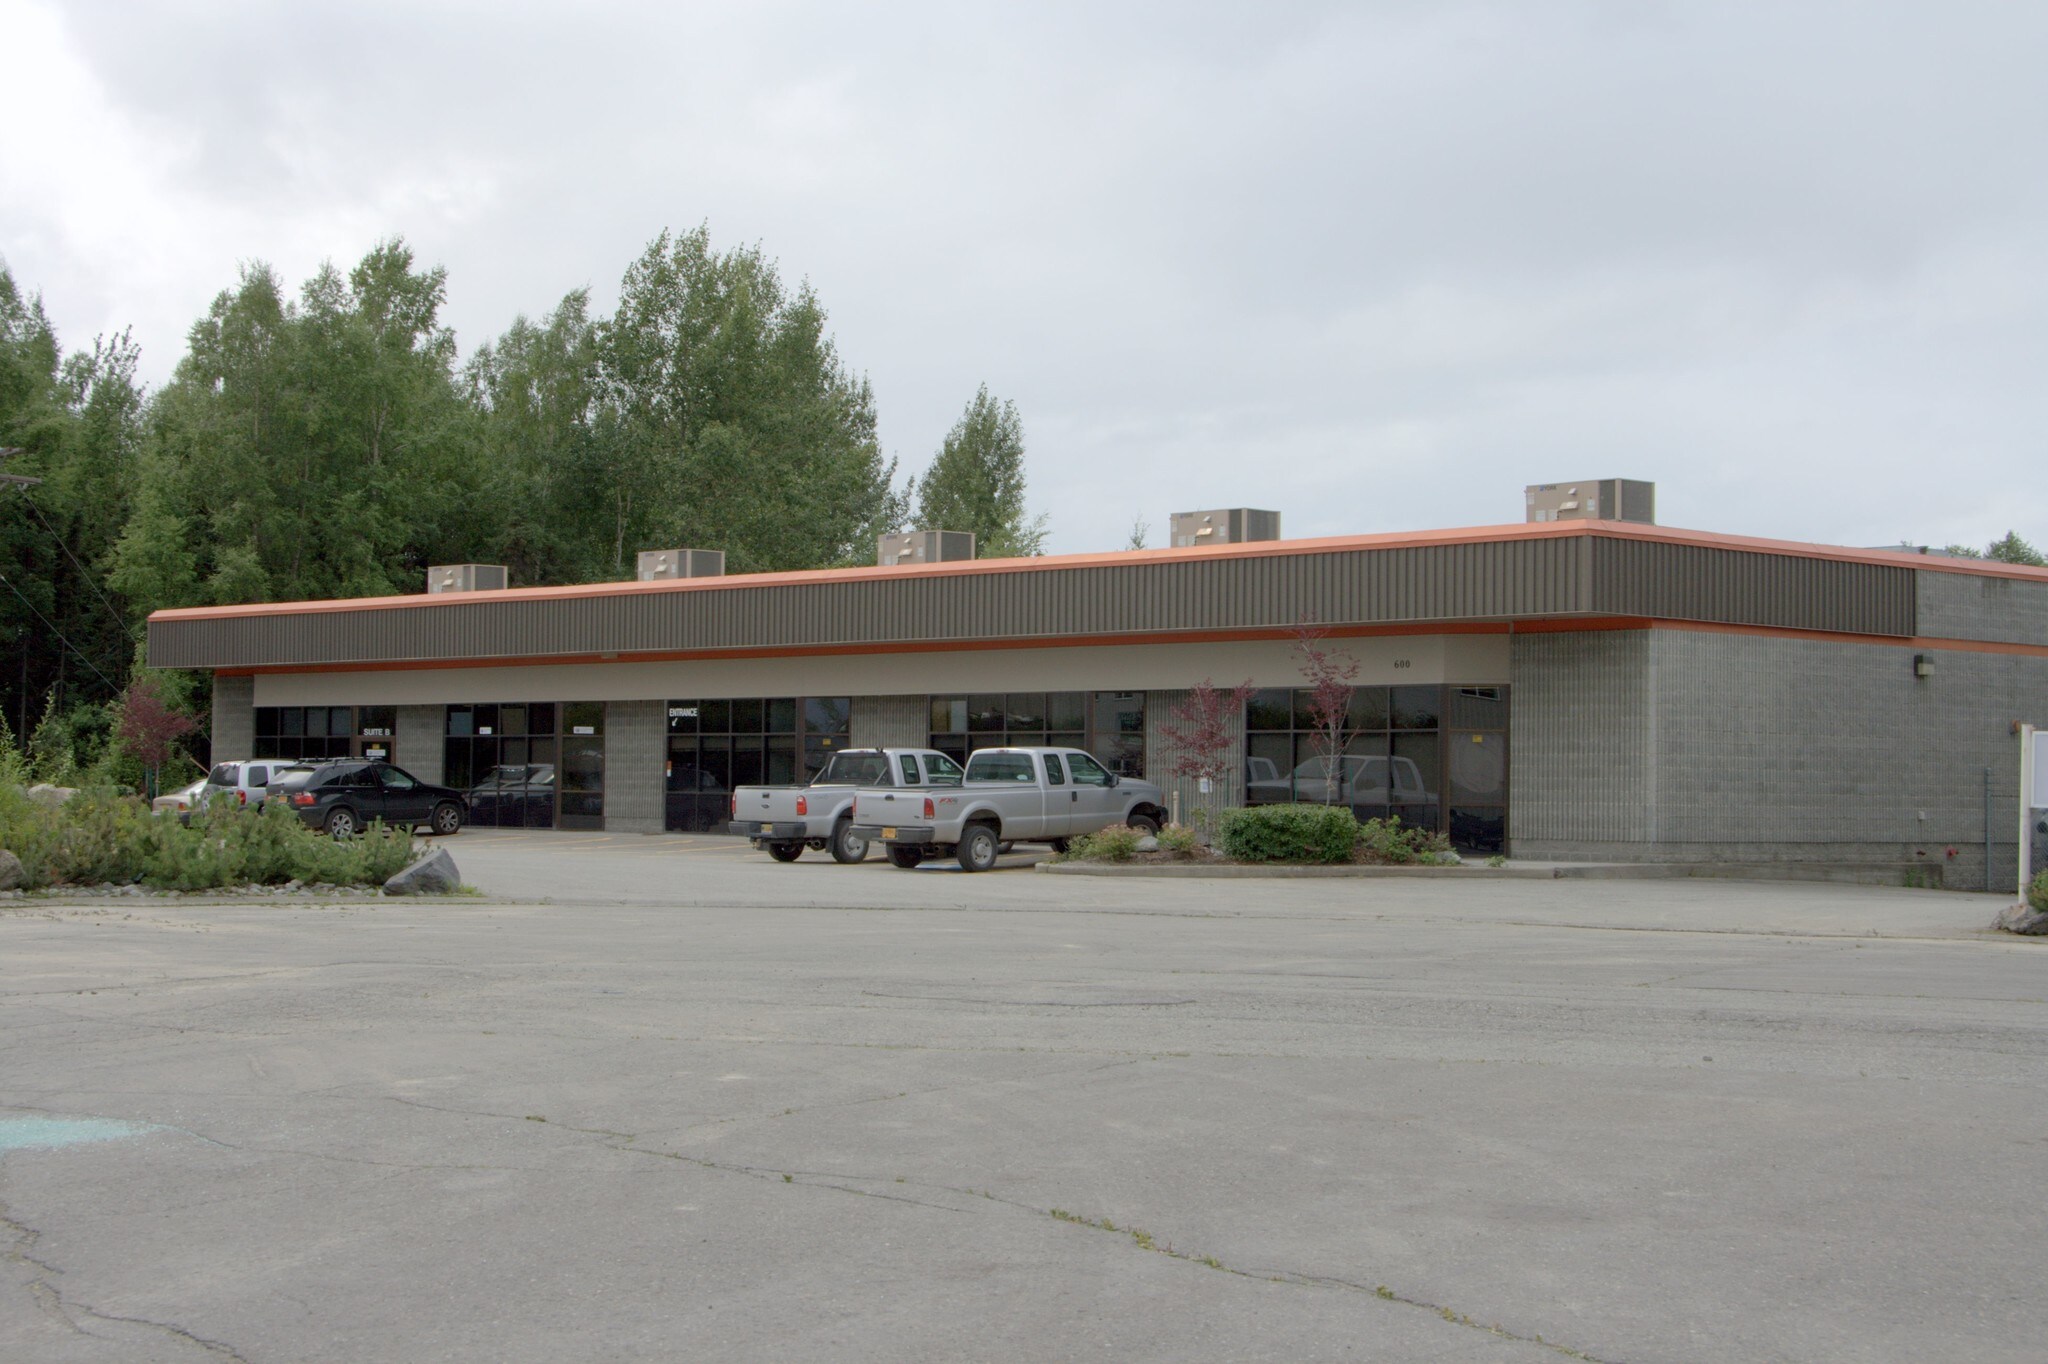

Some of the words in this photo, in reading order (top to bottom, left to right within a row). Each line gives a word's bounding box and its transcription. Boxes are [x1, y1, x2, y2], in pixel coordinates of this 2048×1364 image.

[1394, 660, 1411, 669] 600
[669, 708, 698, 717] ENTRANCE
[363, 728, 383, 736] SUITE
[384, 728, 391, 736] B
